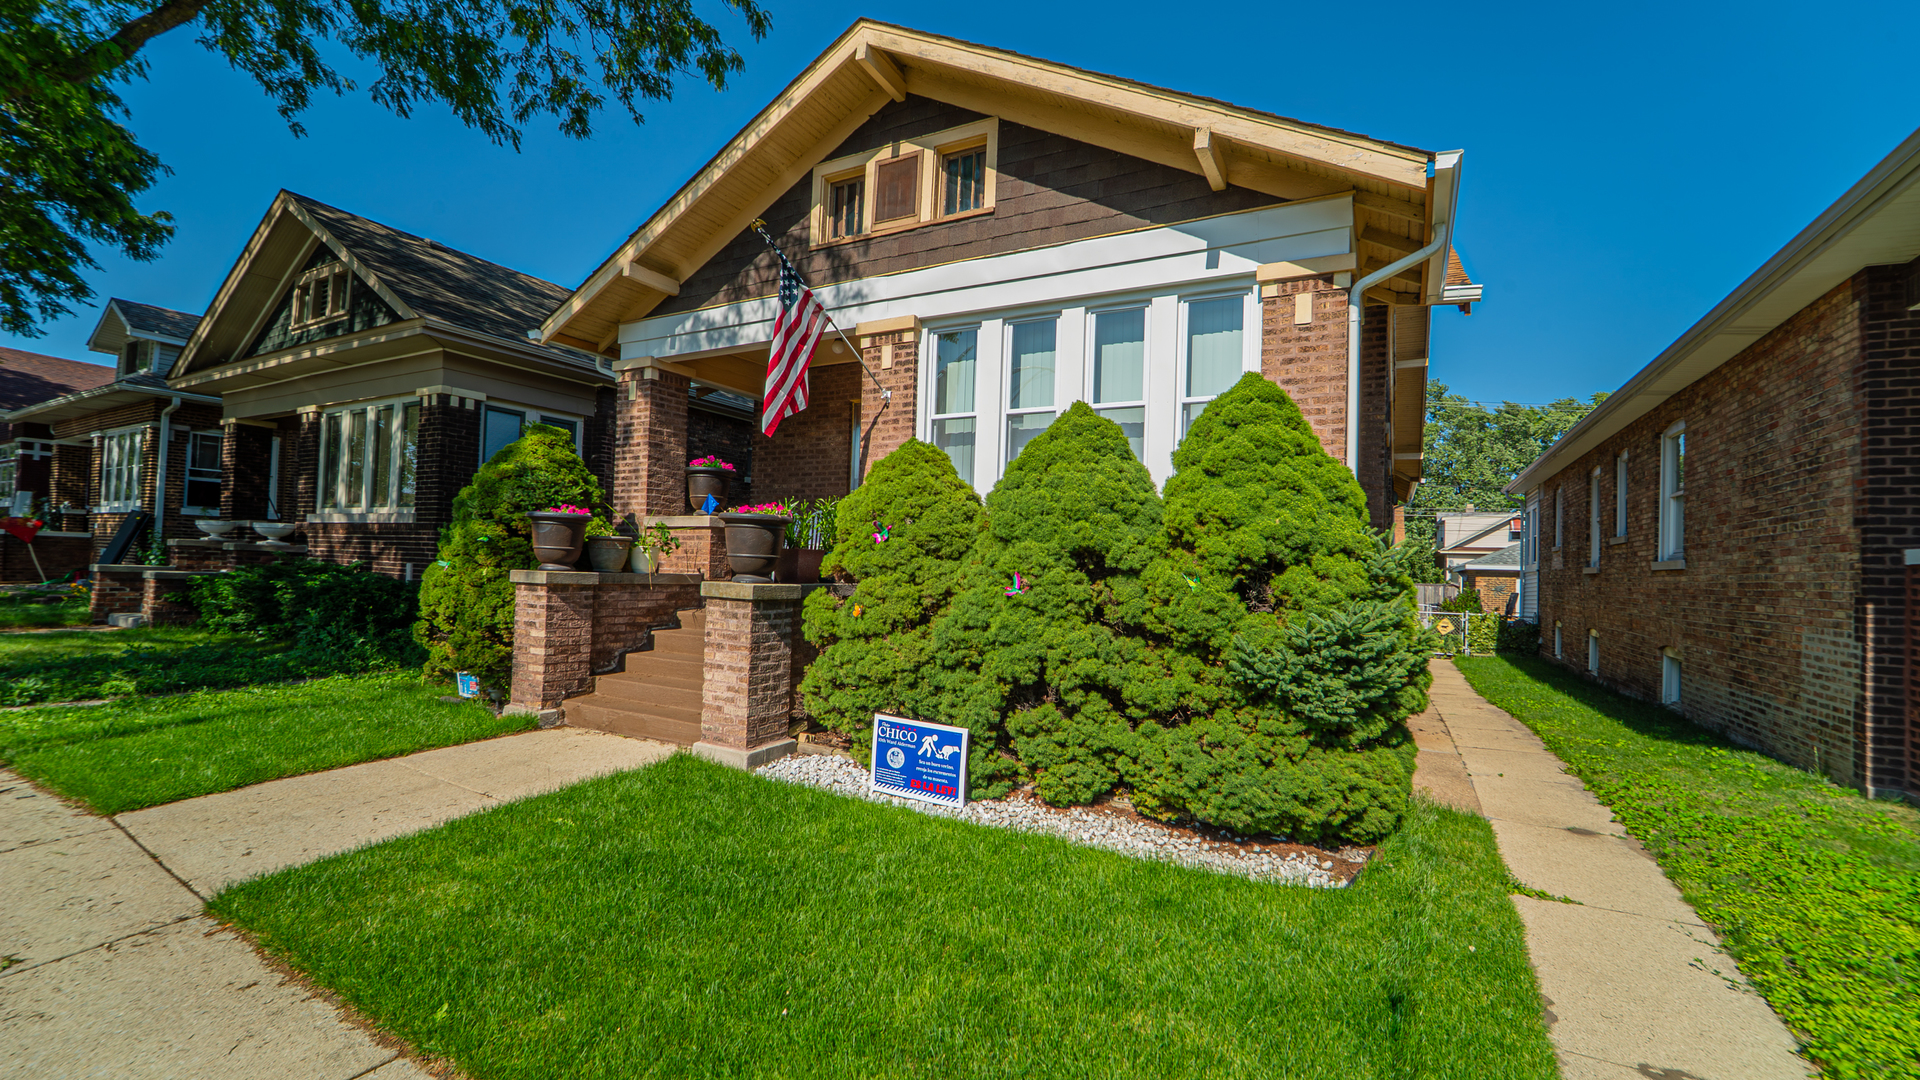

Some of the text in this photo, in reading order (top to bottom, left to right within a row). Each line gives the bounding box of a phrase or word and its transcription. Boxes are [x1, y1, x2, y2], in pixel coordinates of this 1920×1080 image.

[878, 726, 917, 742] CHICO
[897, 741, 916, 749] Alderman
[910, 779, 957, 795] ES LA LEY!
